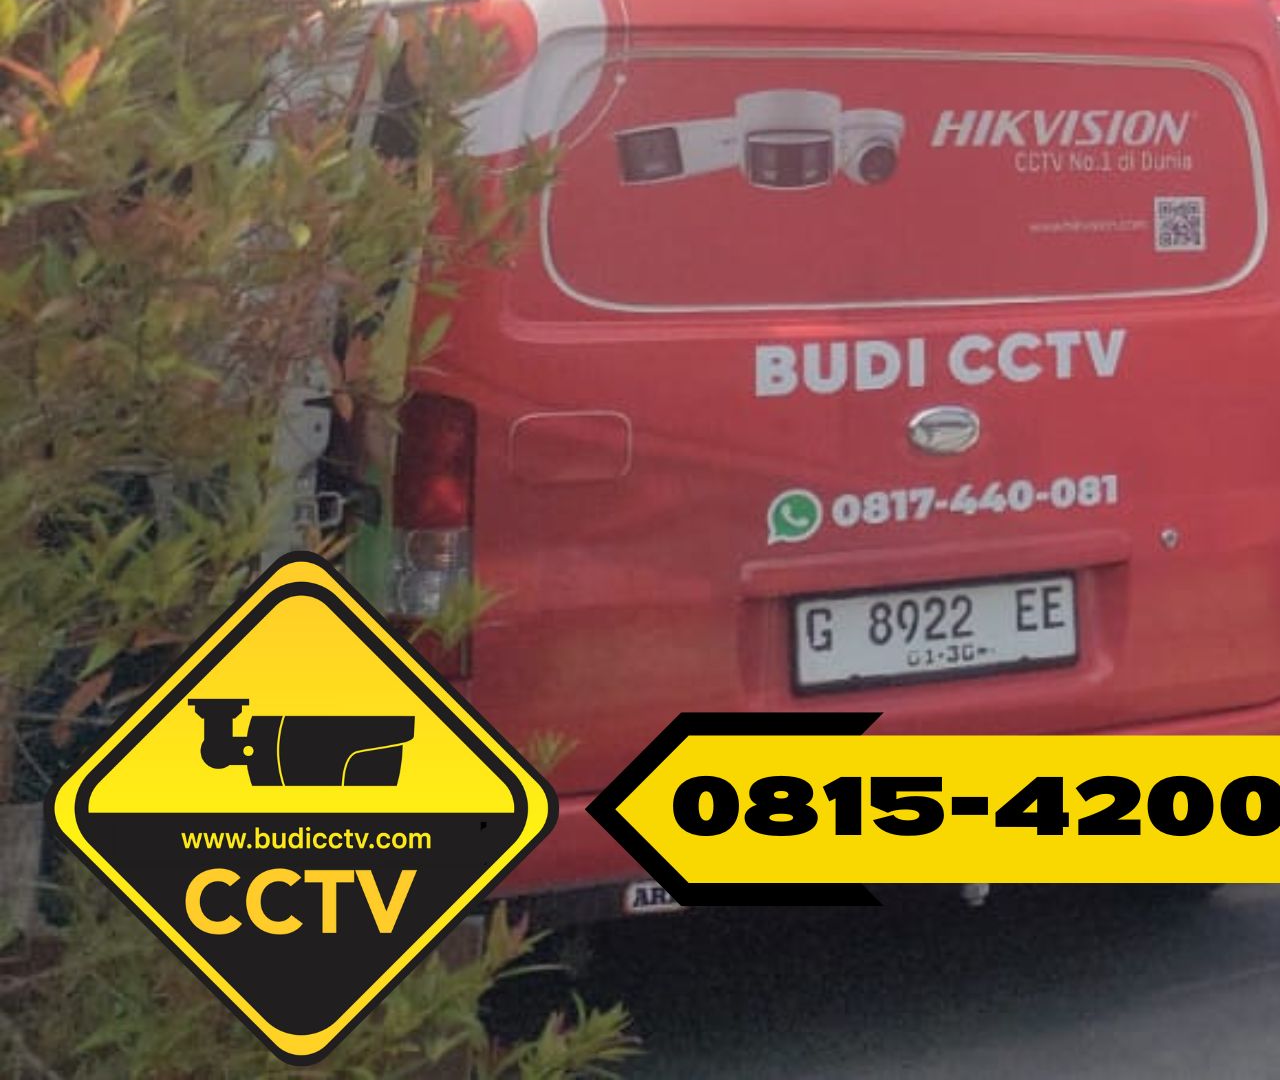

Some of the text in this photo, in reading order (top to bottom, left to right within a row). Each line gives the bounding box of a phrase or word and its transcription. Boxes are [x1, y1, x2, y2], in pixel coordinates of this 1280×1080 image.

[930, 109, 1191, 148] HIKVISION
[1014, 151, 1193, 172] CCTV No.1 di Dunia
[755, 329, 1128, 398] BUDI CCTV
[831, 474, 1119, 528] 0817-440-081
[805, 585, 1066, 652] G 8922 EE
